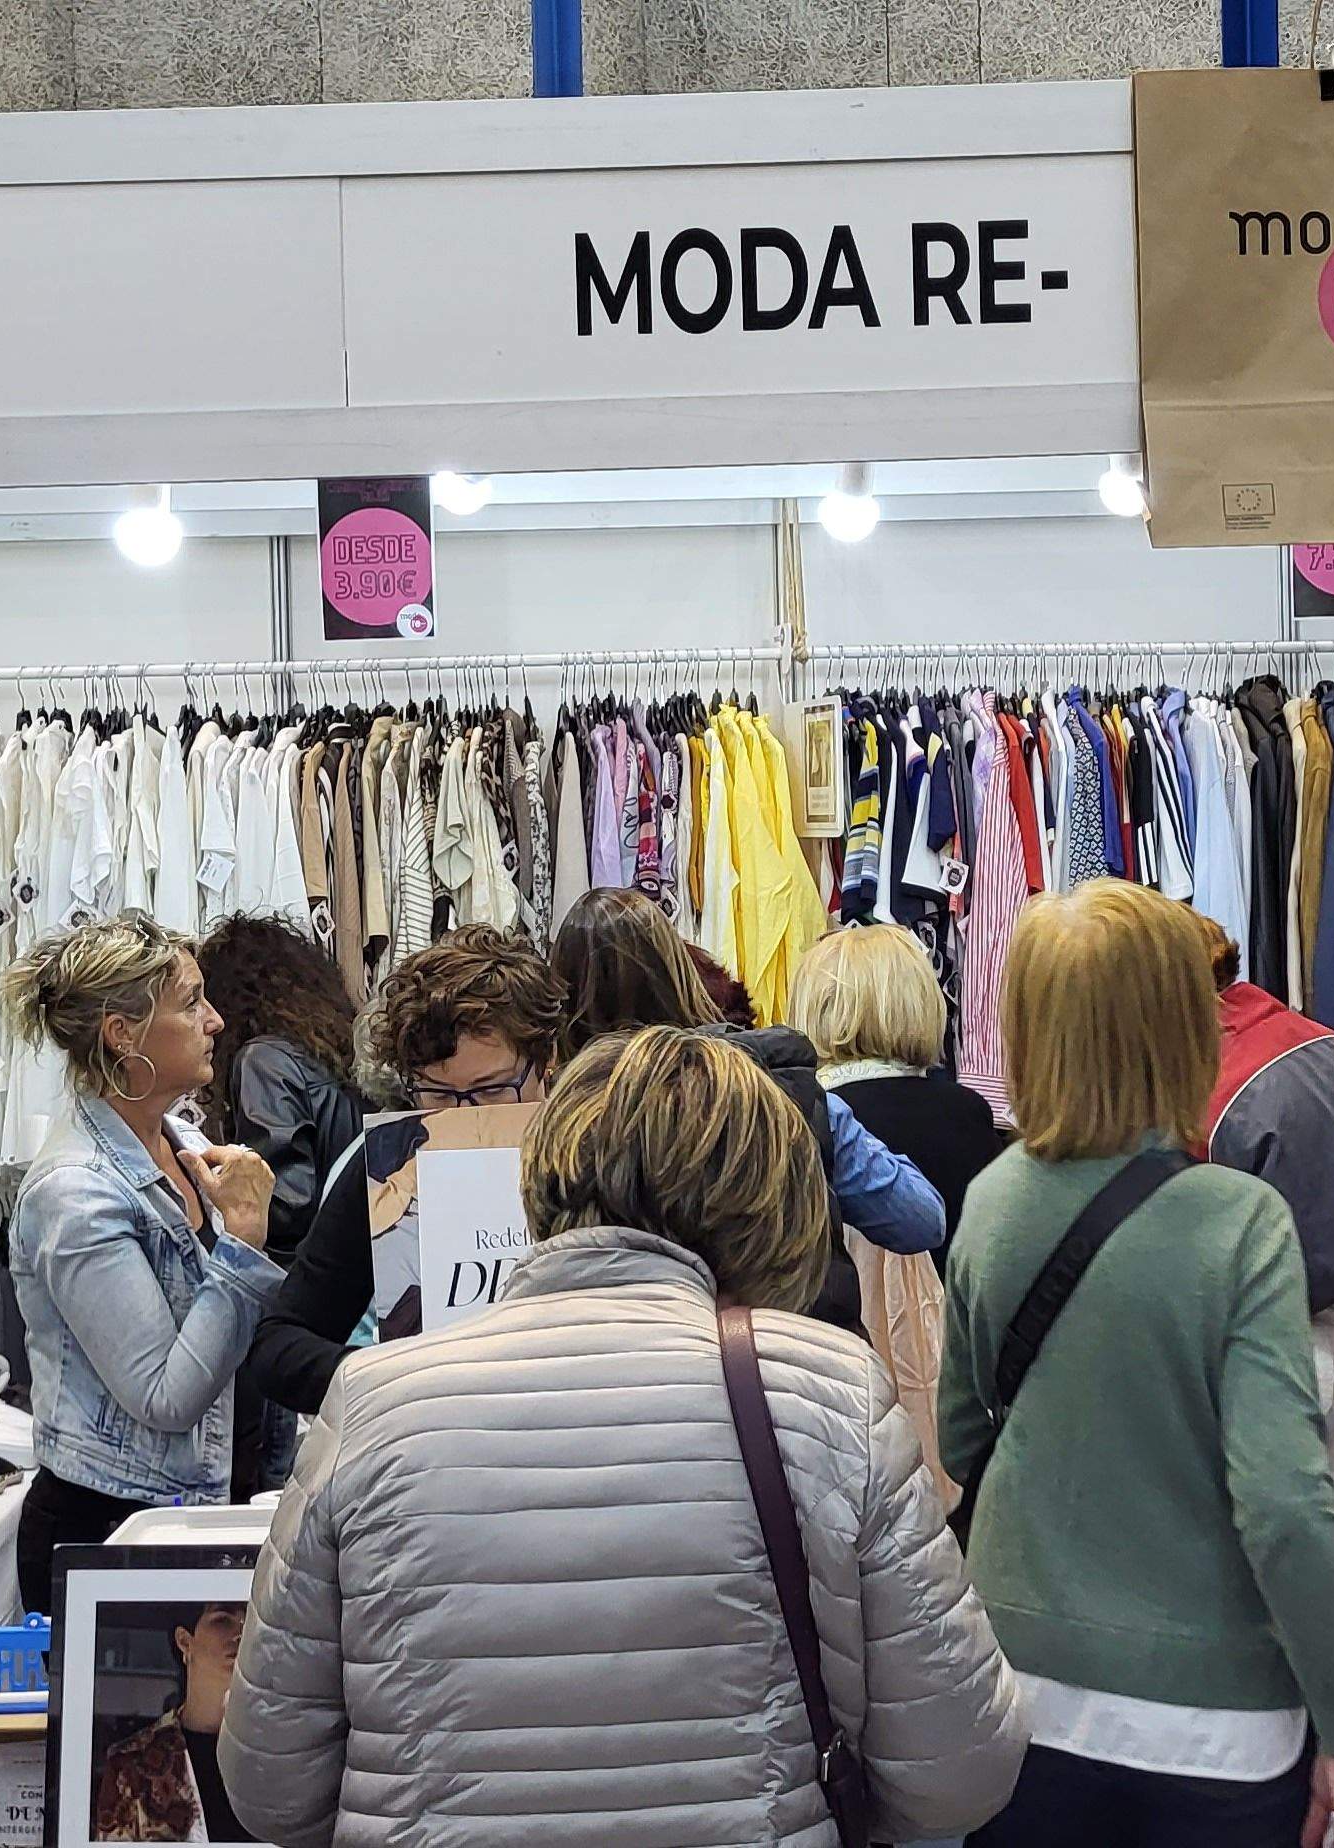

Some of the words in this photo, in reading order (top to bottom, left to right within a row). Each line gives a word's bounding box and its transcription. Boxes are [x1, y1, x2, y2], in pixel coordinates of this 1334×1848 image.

[574, 224, 882, 336] MODA
[910, 219, 1069, 327] RE-
[332, 534, 417, 565] DESDE
[334, 570, 417, 600] 3.90€
